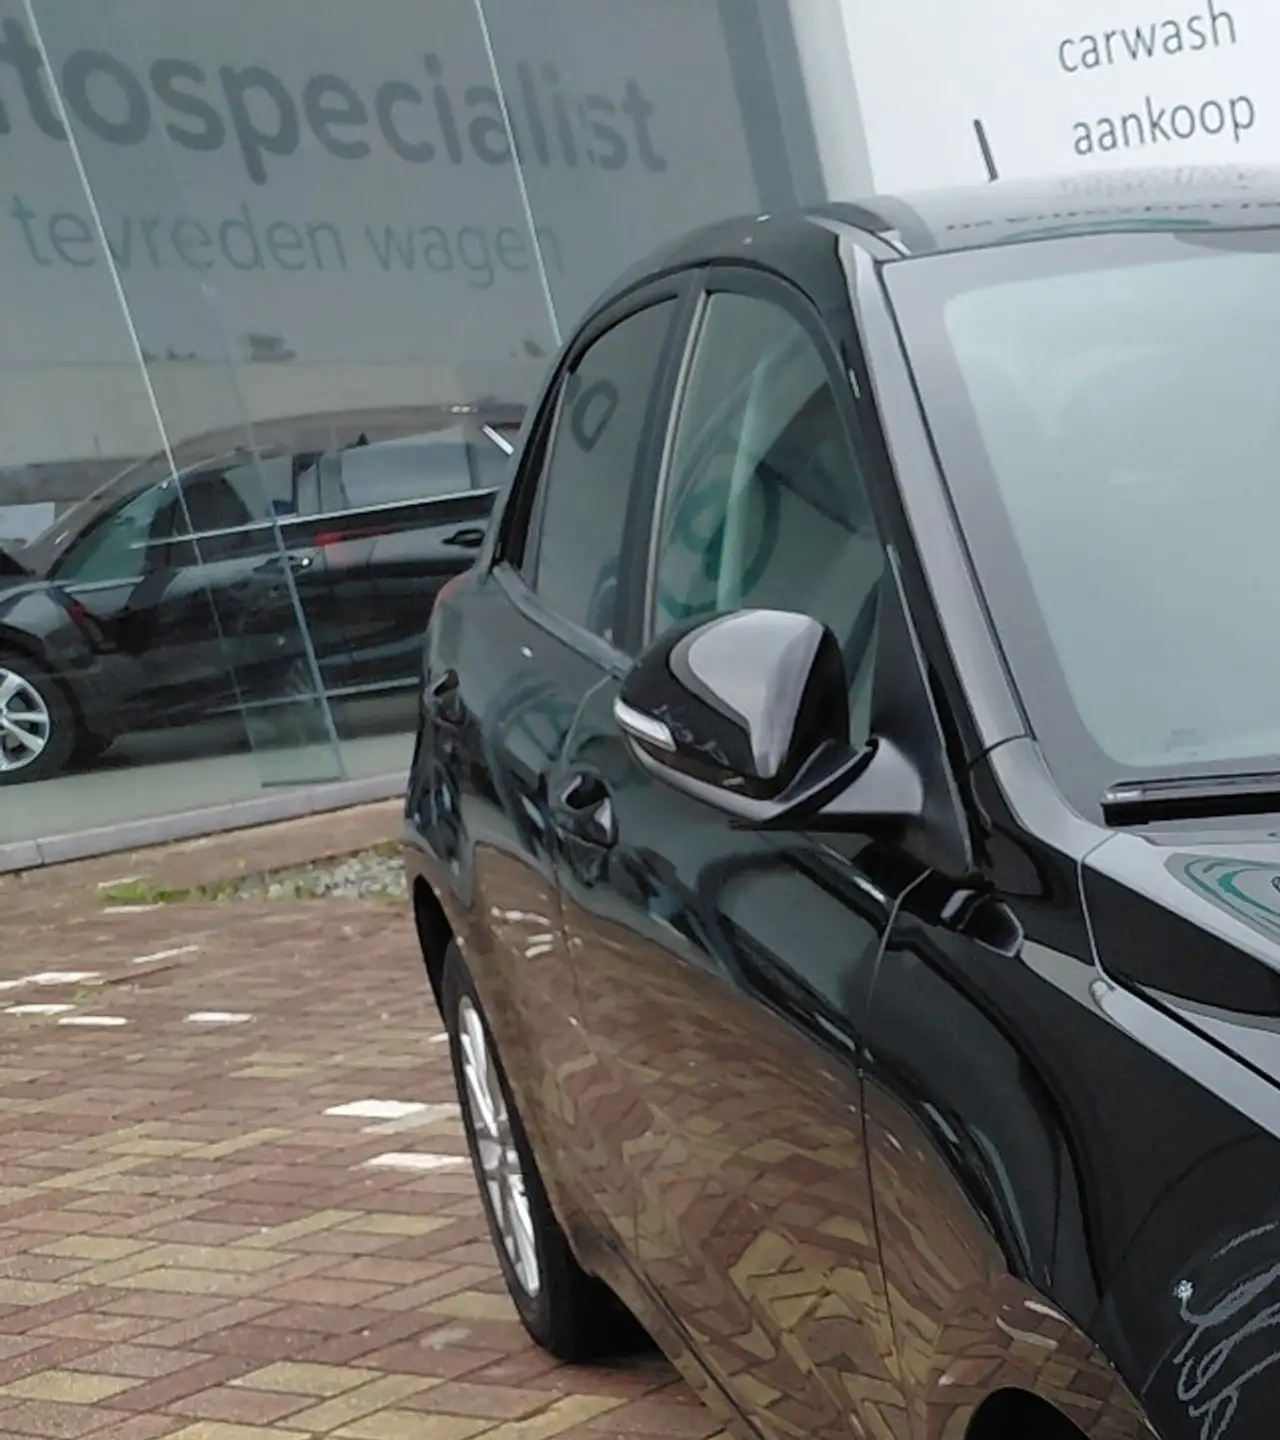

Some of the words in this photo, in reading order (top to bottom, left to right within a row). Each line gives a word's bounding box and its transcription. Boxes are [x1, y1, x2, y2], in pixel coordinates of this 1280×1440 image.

[1058, 0, 1236, 72] carwash
[0, 18, 667, 186] tospecialist
[1073, 94, 1255, 155] aankoop
[10, 193, 349, 272] tevreden
[364, 220, 565, 290] wagen
